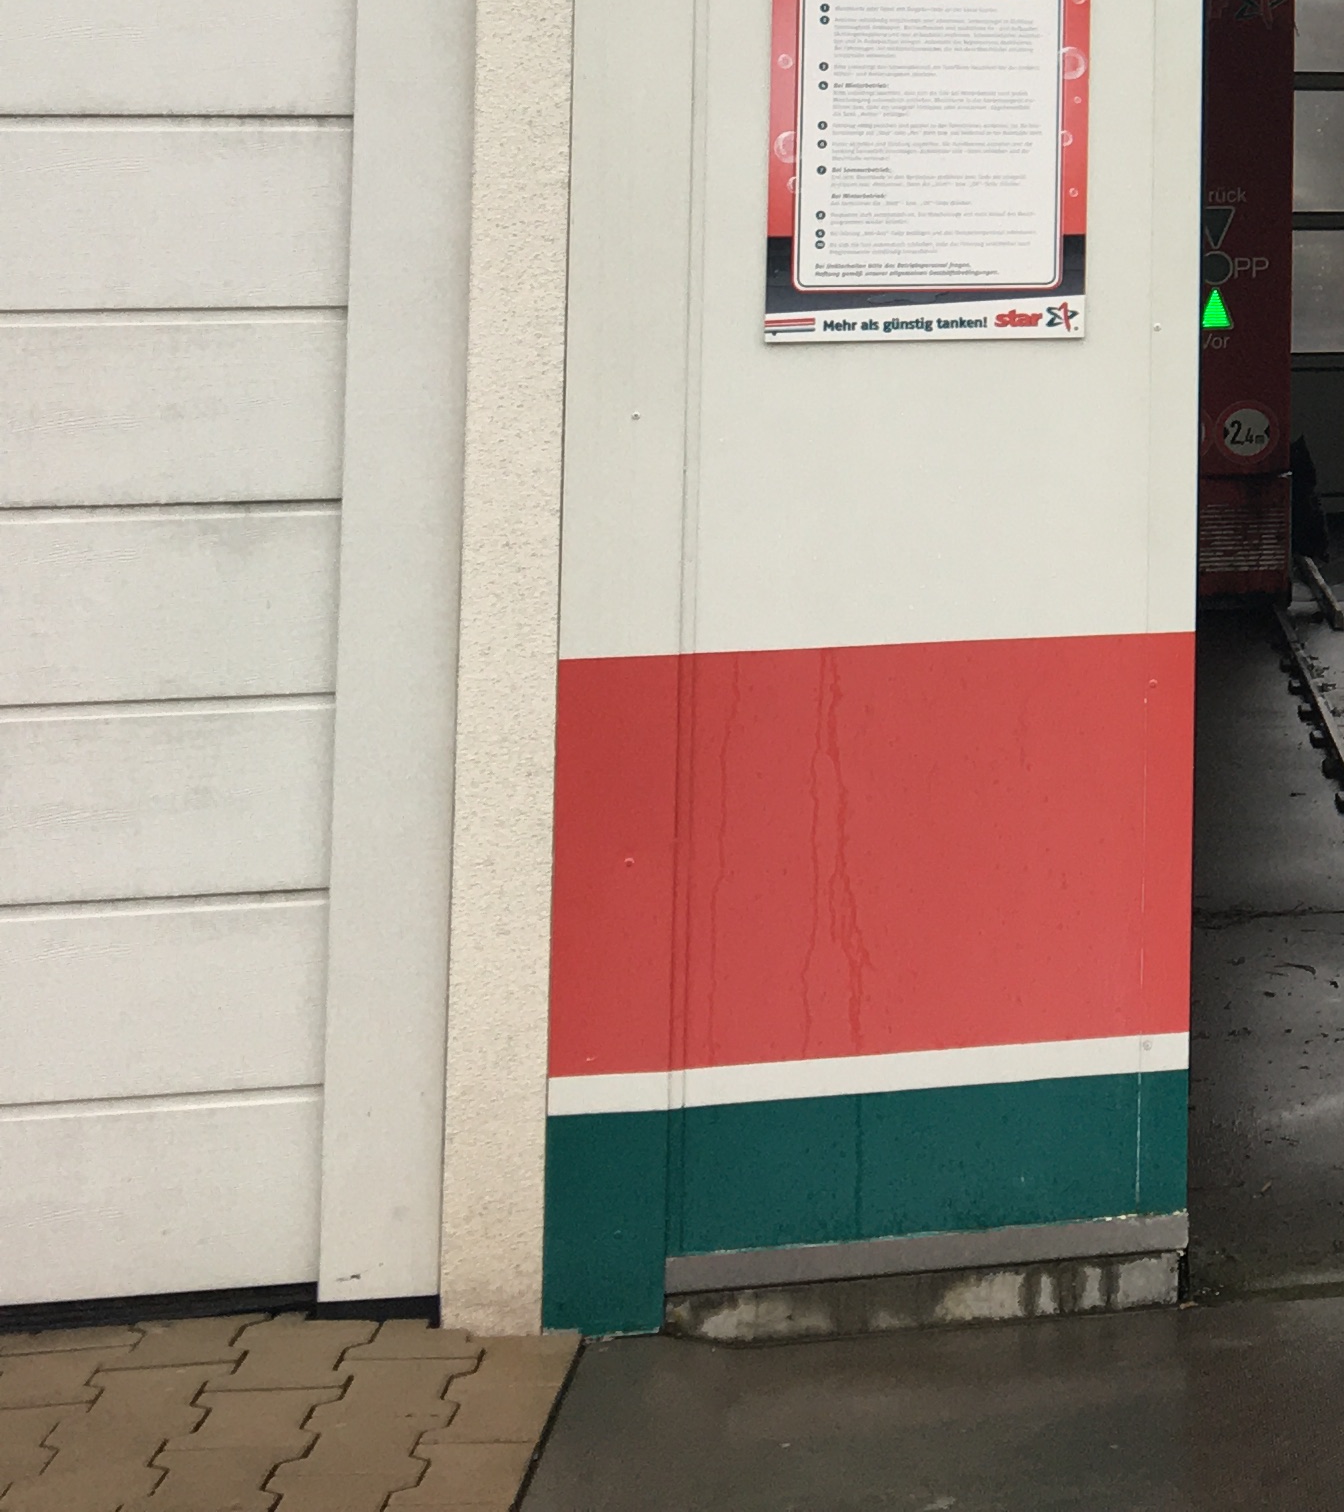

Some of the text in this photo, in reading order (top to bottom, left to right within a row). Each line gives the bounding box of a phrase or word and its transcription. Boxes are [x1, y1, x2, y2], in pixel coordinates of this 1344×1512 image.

[823, 316, 988, 333] Mehr als günstig tanken!
[994, 309, 1043, 328] star
